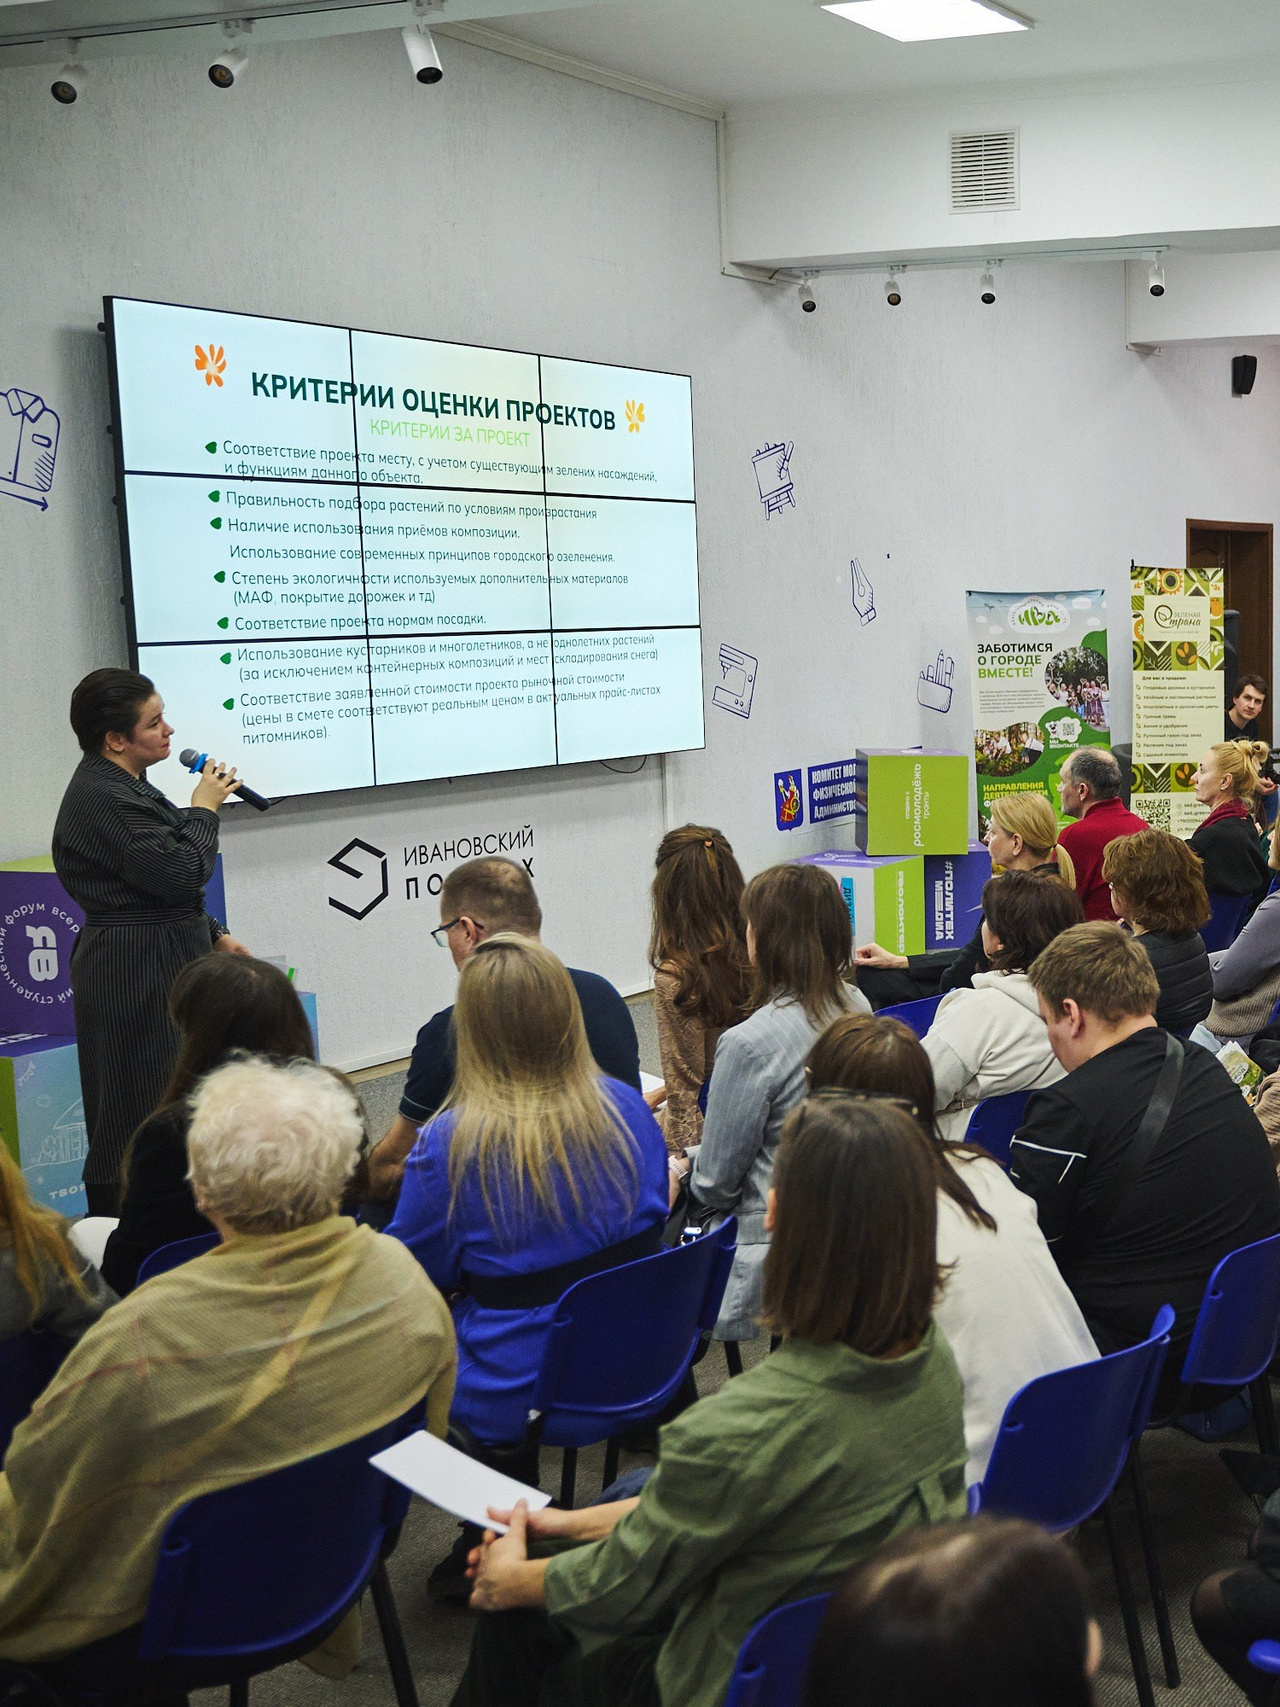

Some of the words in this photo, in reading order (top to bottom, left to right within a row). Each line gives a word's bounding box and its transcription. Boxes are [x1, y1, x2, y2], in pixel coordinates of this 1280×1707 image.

[252, 372, 394, 409] КРИТЕРИИ
[402, 388, 500, 419] ОЦЕНКИ
[506, 399, 616, 430] ПРОЕКТОВ
[370, 419, 450, 440] КРИТЕРИИ
[454, 426, 473, 443] ЗА
[477, 428, 530, 447] ПРОЕКТ
[223, 440, 316, 459] Соответствие
[320, 449, 374, 464] проекта
[418, 456, 424, 466] с
[427, 457, 467, 470] учетом
[224, 464, 233, 473] и
[237, 461, 307, 482] функциям
[311, 468, 367, 481] данного
[371, 469, 423, 484] объекта.
[226, 491, 325, 509] Правильность
[329, 497, 385, 513] подбора
[390, 501, 444, 514] растений
[448, 503, 462, 514] по
[464, 505, 516, 517] условиям
[228, 518, 289, 533] Наличие
[293, 523, 394, 536] использования
[398, 524, 448, 538] приёмов
[451, 528, 520, 539] композиции.
[230, 544, 336, 559] Использование
[340, 549, 425, 562] современных
[428, 550, 490, 562] принципов
[557, 552, 615, 563] озеленения.
[232, 571, 288, 585] Степень
[292, 574, 389, 585] экологичности
[393, 574, 476, 587] используемых
[480, 573, 569, 586] дополнительных
[571, 574, 628, 587] материалов
[281, 592, 344, 606] покрытие
[348, 592, 406, 606] дорожек
[408, 592, 416, 601] и
[419, 590, 436, 604] тд)
[235, 617, 327, 631] Соответствие
[330, 618, 384, 632] проекта
[388, 616, 433, 629] нормам
[437, 614, 486, 626] посадки.
[237, 647, 343, 662] Использование
[346, 643, 426, 660] кустарников
[429, 643, 436, 652] и
[440, 639, 525, 653] многолетников,
[527, 639, 534, 648] а
[536, 639, 549, 648] не
[553, 637, 610, 649] однолетних
[612, 634, 654, 647] растений
[977, 643, 1053, 654] ЗАБОТИМСЯ
[239, 667, 260, 683] (за
[263, 664, 353, 679] исключением
[356, 659, 446, 675] контейнерных
[448, 655, 515, 670] композиций
[517, 656, 524, 665] и
[526, 655, 549, 665] мест
[554, 652, 628, 665] складирования
[630, 649, 658, 661] снега)
[977, 656, 987, 666] О
[991, 655, 1042, 666] ГОРОДЕ
[978, 667, 1033, 679] ВМЕСТЕ!
[240, 690, 331, 707] Соответствие
[335, 684, 411, 701] заявленной
[414, 680, 472, 695] стоимости
[475, 679, 519, 694] проекта
[577, 673, 625, 685] стоимости
[242, 711, 282, 728] (цены
[286, 712, 293, 722] в
[297, 709, 334, 721] смете
[338, 702, 428, 718] соответствуют
[432, 698, 489, 714] реальным
[491, 696, 525, 708] ценам
[527, 694, 533, 703] в
[599, 686, 661, 701] прайс-листах
[811, 766, 842, 784] КОМИТЕТ
[983, 781, 1044, 791] НАПРАВЛЕНИЯ
[911, 763, 924, 847] росмолодёжь
[404, 825, 534, 867] ИВАНОВСКИЙ
[944, 860, 954, 941] #ПОЛИТЕХ
[5, 903, 45, 925] форум
